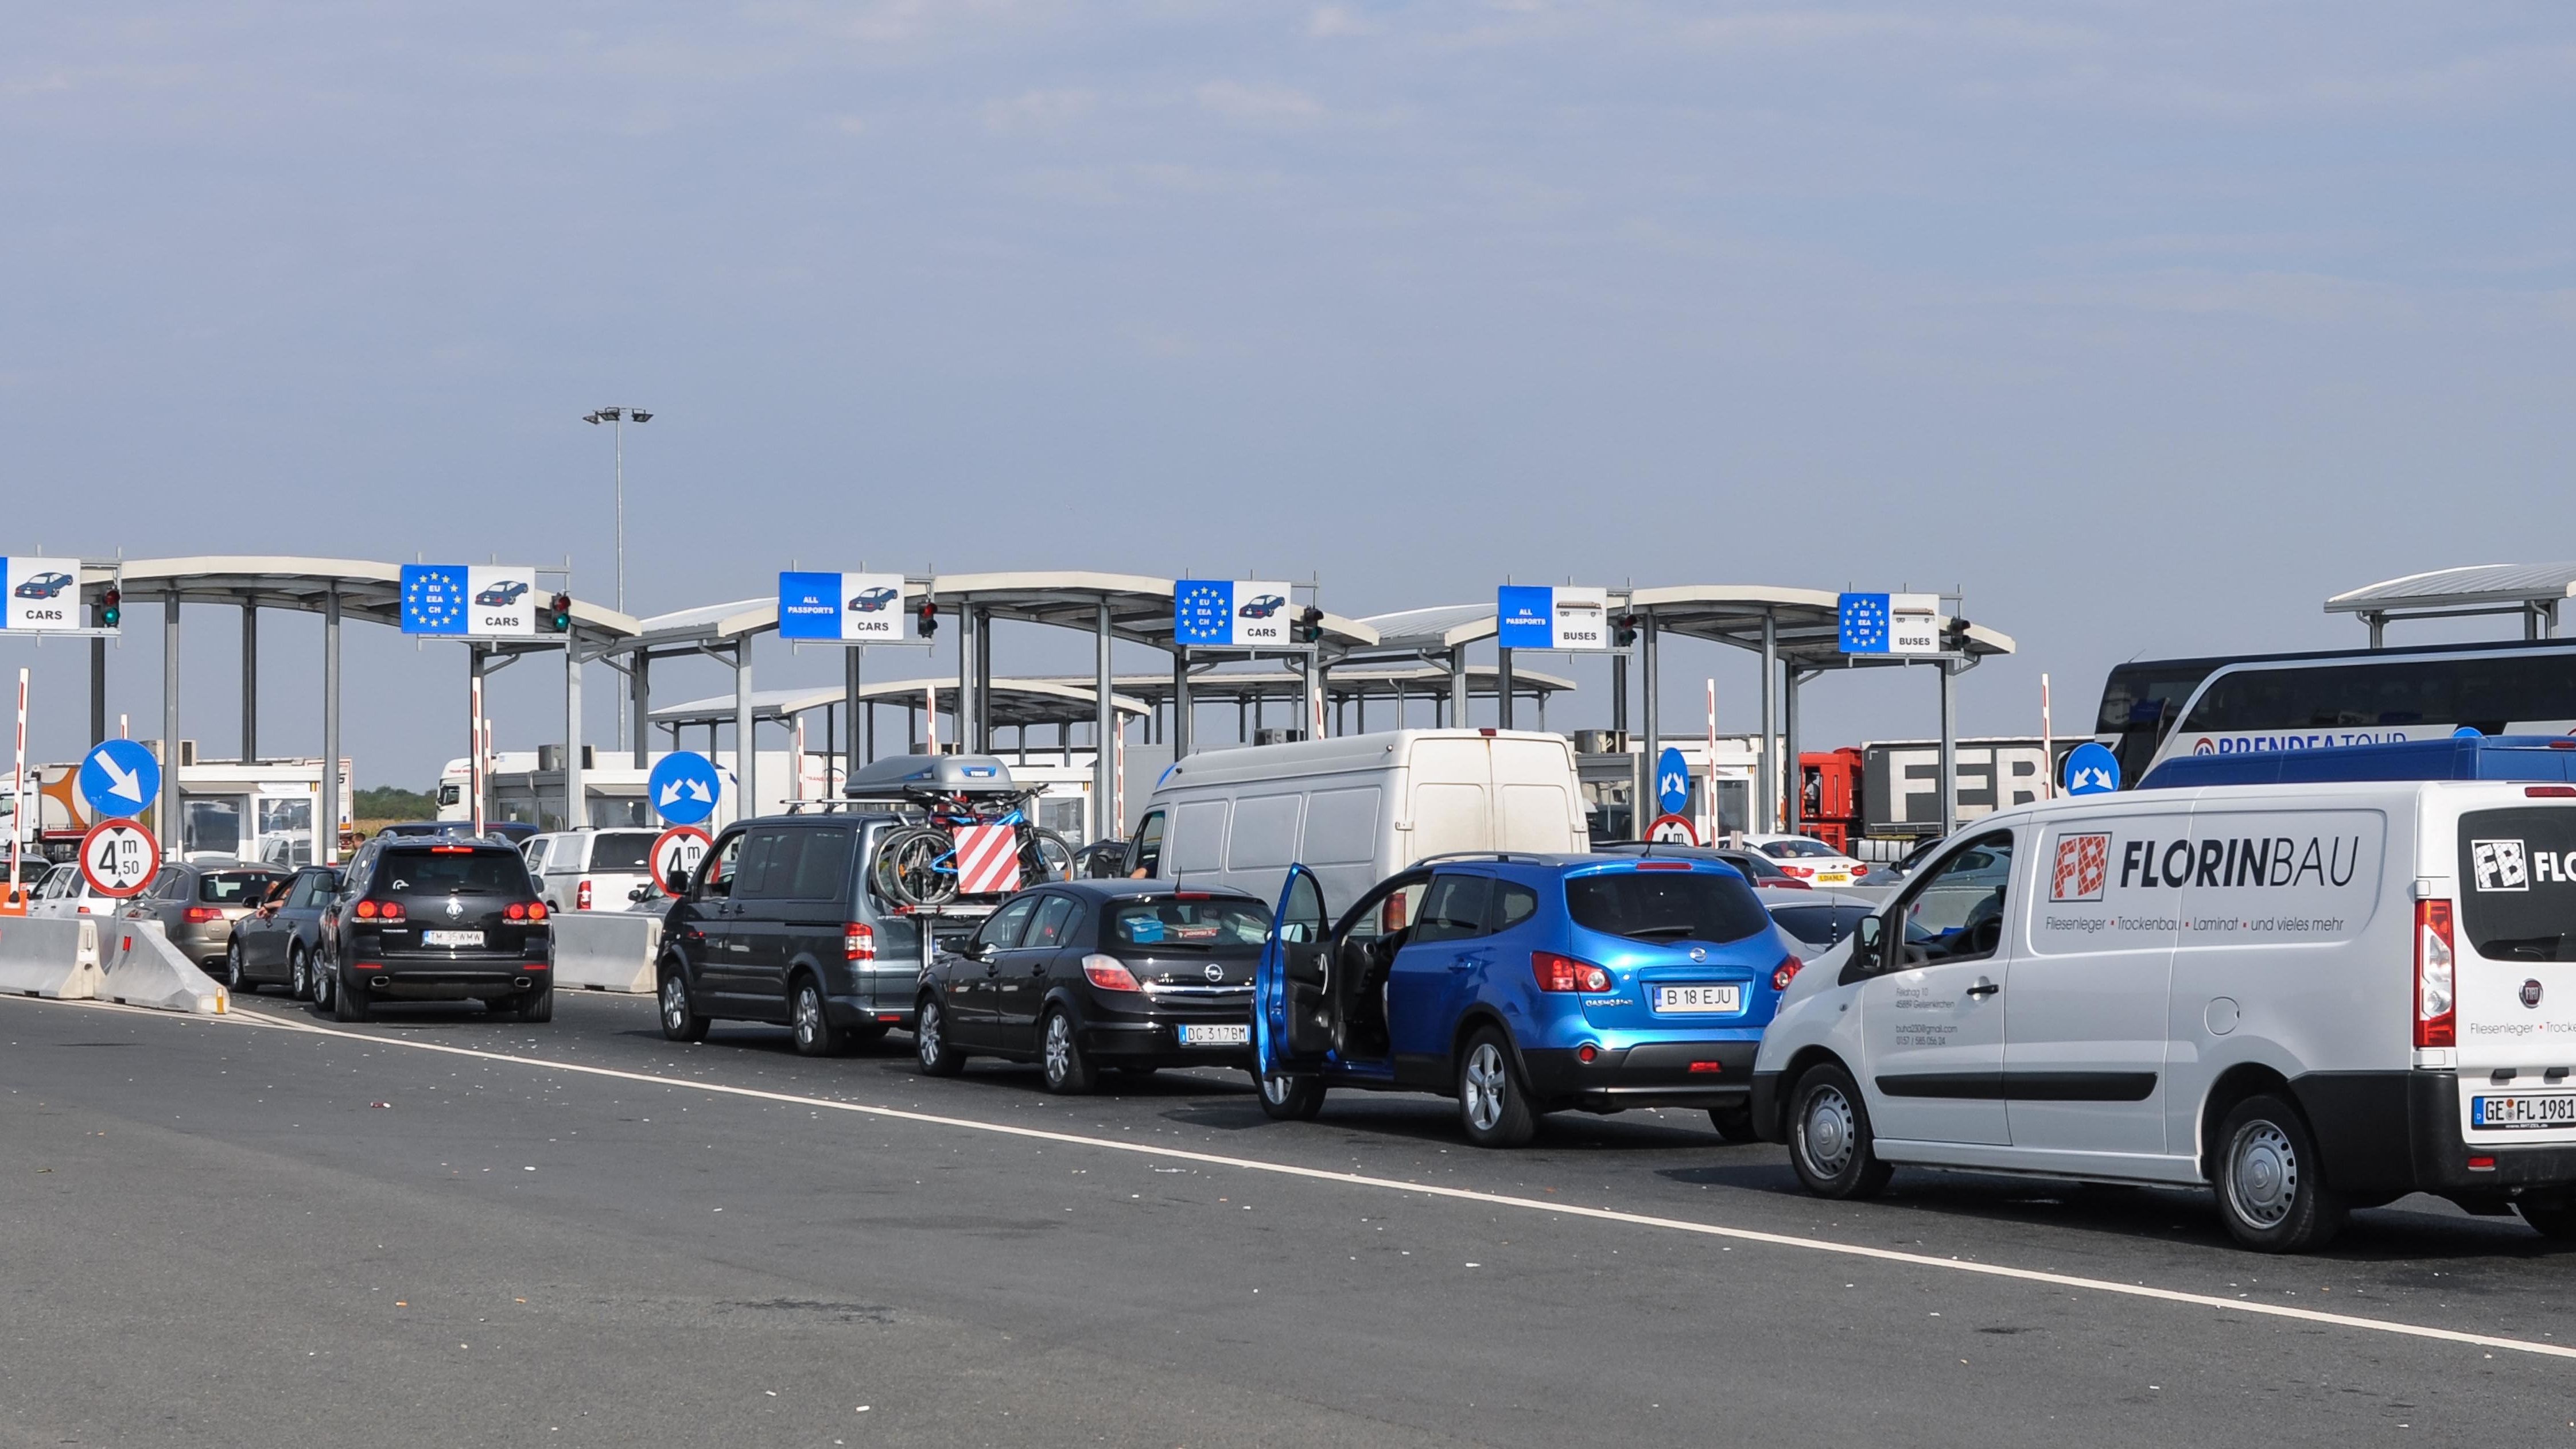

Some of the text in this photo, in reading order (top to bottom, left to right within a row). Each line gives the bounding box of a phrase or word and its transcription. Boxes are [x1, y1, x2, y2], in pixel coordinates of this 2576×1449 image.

[26, 610, 63, 620] CARS
[787, 607, 834, 615] PASSPORTS
[485, 617, 519, 626] CARS
[857, 622, 889, 631] CARS
[1248, 628, 1276, 637] CARS
[1564, 632, 1597, 640] BUSES
[1899, 638, 1930, 646] BUSES
[1889, 748, 2070, 822] FER
[2055, 836, 2359, 898] FB FLORINBAU
[2476, 843, 2525, 888] FB
[2046, 916, 2344, 933] Fliesenleger Trockenbau Laminat und vieles mehr
[1667, 989, 1731, 1005] B 18 EJU
[1188, 1027, 1203, 1040] DG
[2470, 1023, 2534, 1036] Fliesenleger
[2486, 1099, 2574, 1121] GE FL 1981
